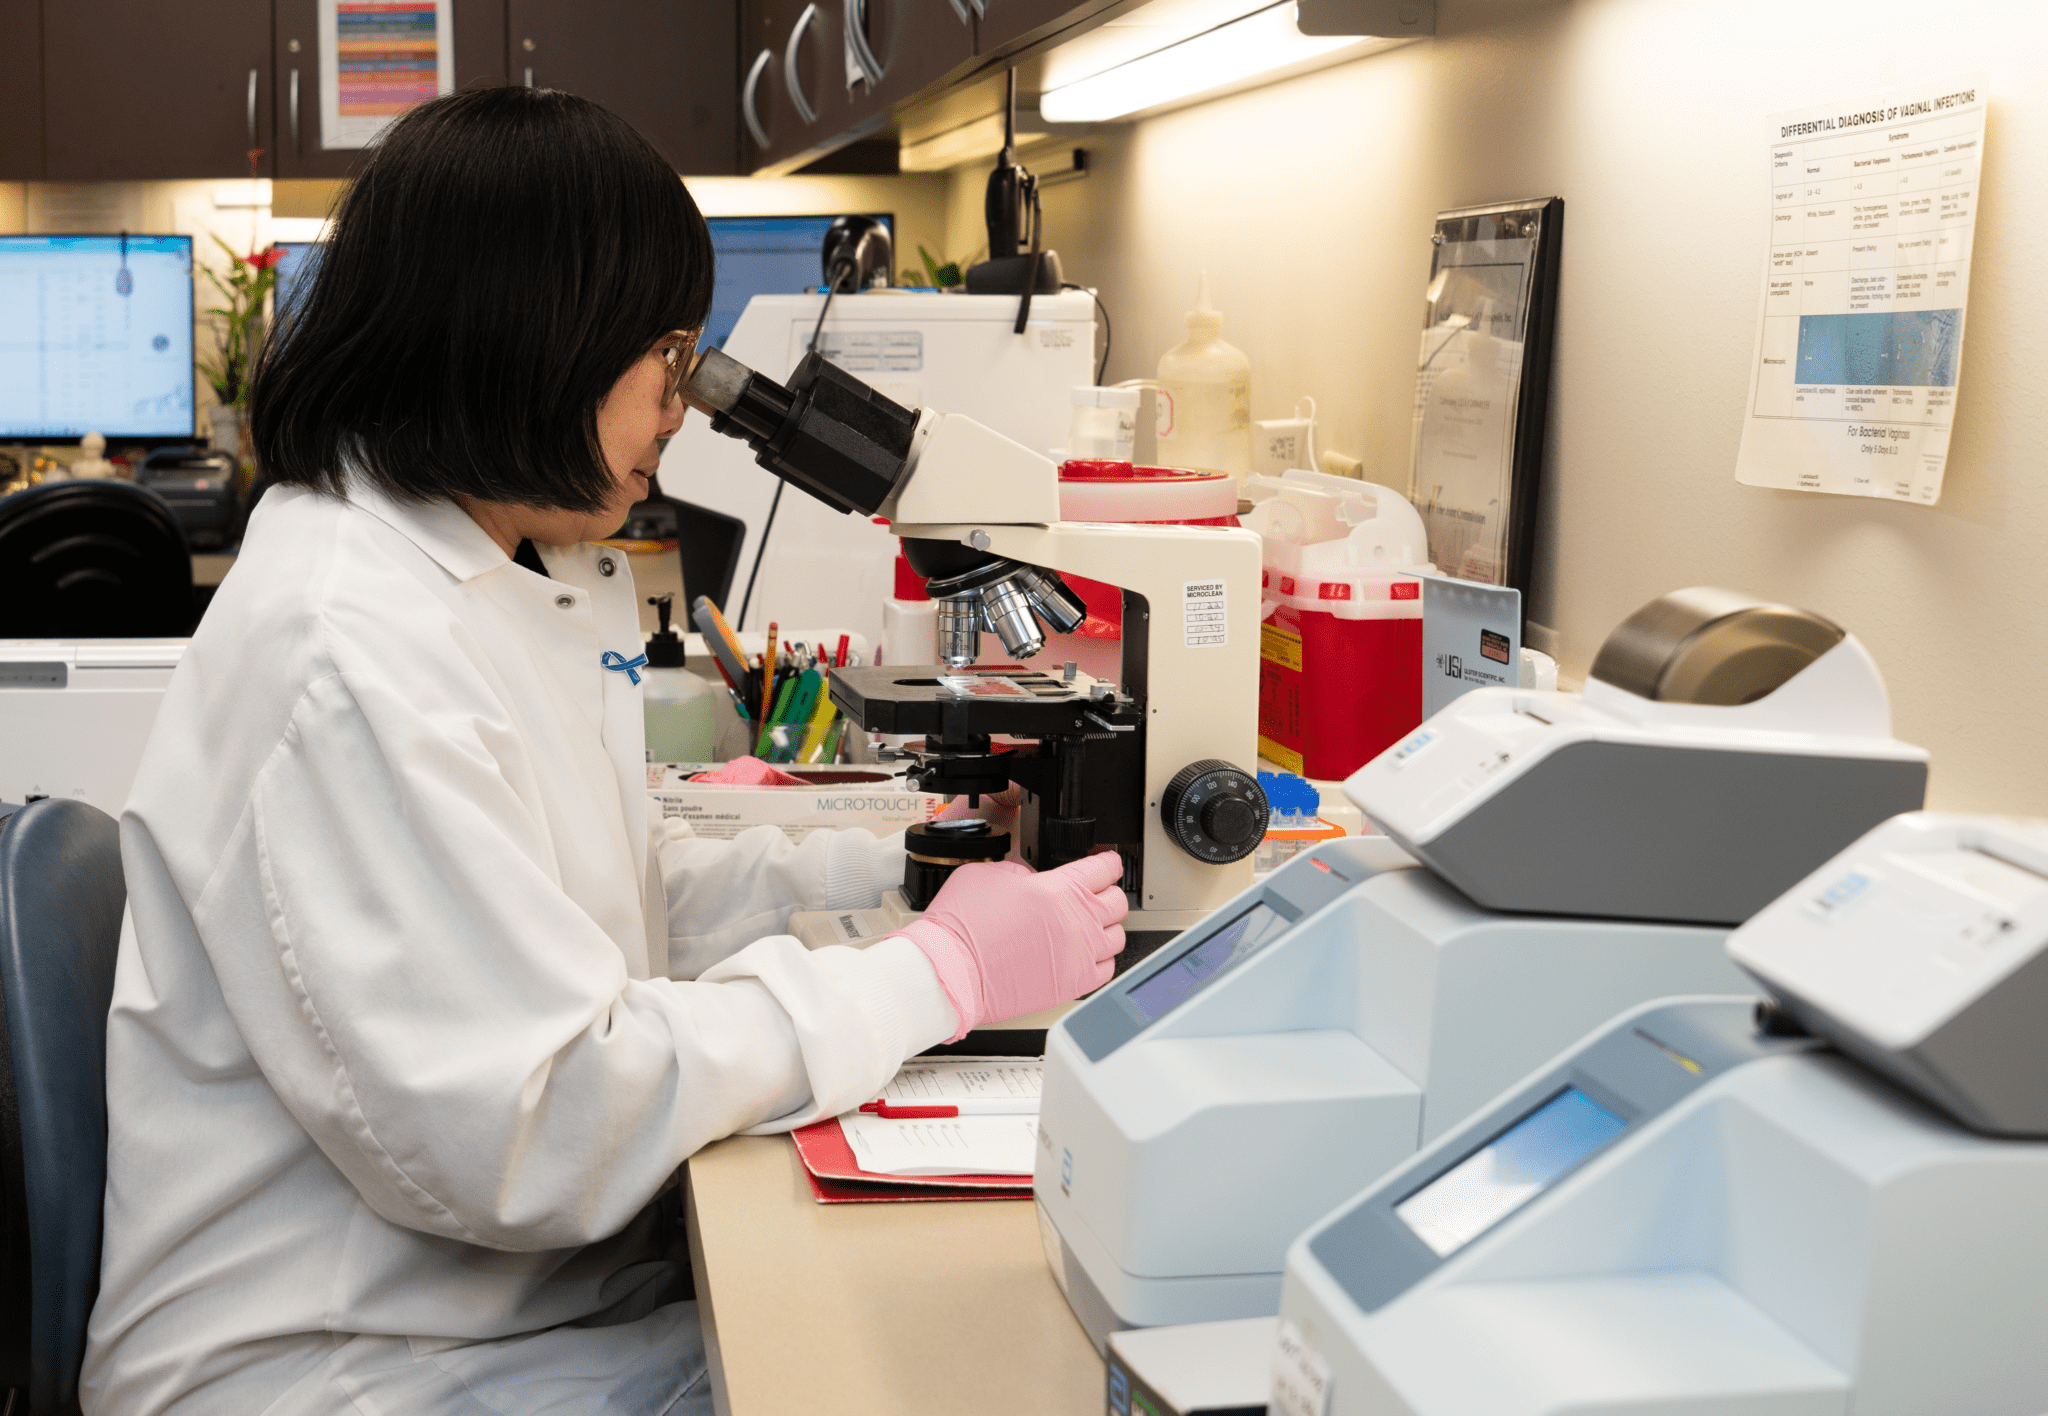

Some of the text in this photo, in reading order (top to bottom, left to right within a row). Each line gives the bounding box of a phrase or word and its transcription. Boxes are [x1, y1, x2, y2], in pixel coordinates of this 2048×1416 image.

[1781, 89, 1975, 138] DIFFERENTIAL DIAGNOSIS OF VAGINAL INFECTIONS
[1888, 133, 1909, 142] Syndrome
[1774, 151, 1793, 159] Diagnostic
[1853, 157, 1891, 168] Bacterial Vaginosis
[1775, 193, 1787, 201] Vaginal
[1779, 281, 1793, 289] patient
[1847, 425, 1911, 441] For Bacterial Vaginosis
[1860, 444, 1873, 455] Only
[1873, 445, 1878, 454] 5
[1877, 445, 1889, 456] Days
[1187, 590, 1223, 598] MICROCLEAN
[1444, 654, 1462, 680] USI
[1464, 668, 1478, 676] ULSTER
[1206, 781, 1217, 790] 120
[1227, 780, 1238, 789] 140
[1191, 794, 1201, 804] 100
[1245, 790, 1255, 800] 160
[663, 796, 682, 804] Nitrile
[663, 804, 703, 813] Sans poudre
[682, 812, 713, 820] d'examen
[715, 812, 741, 820] médical
[1186, 815, 1194, 824] 80
[1193, 834, 1202, 843] 60
[1209, 846, 1218, 854] 40
